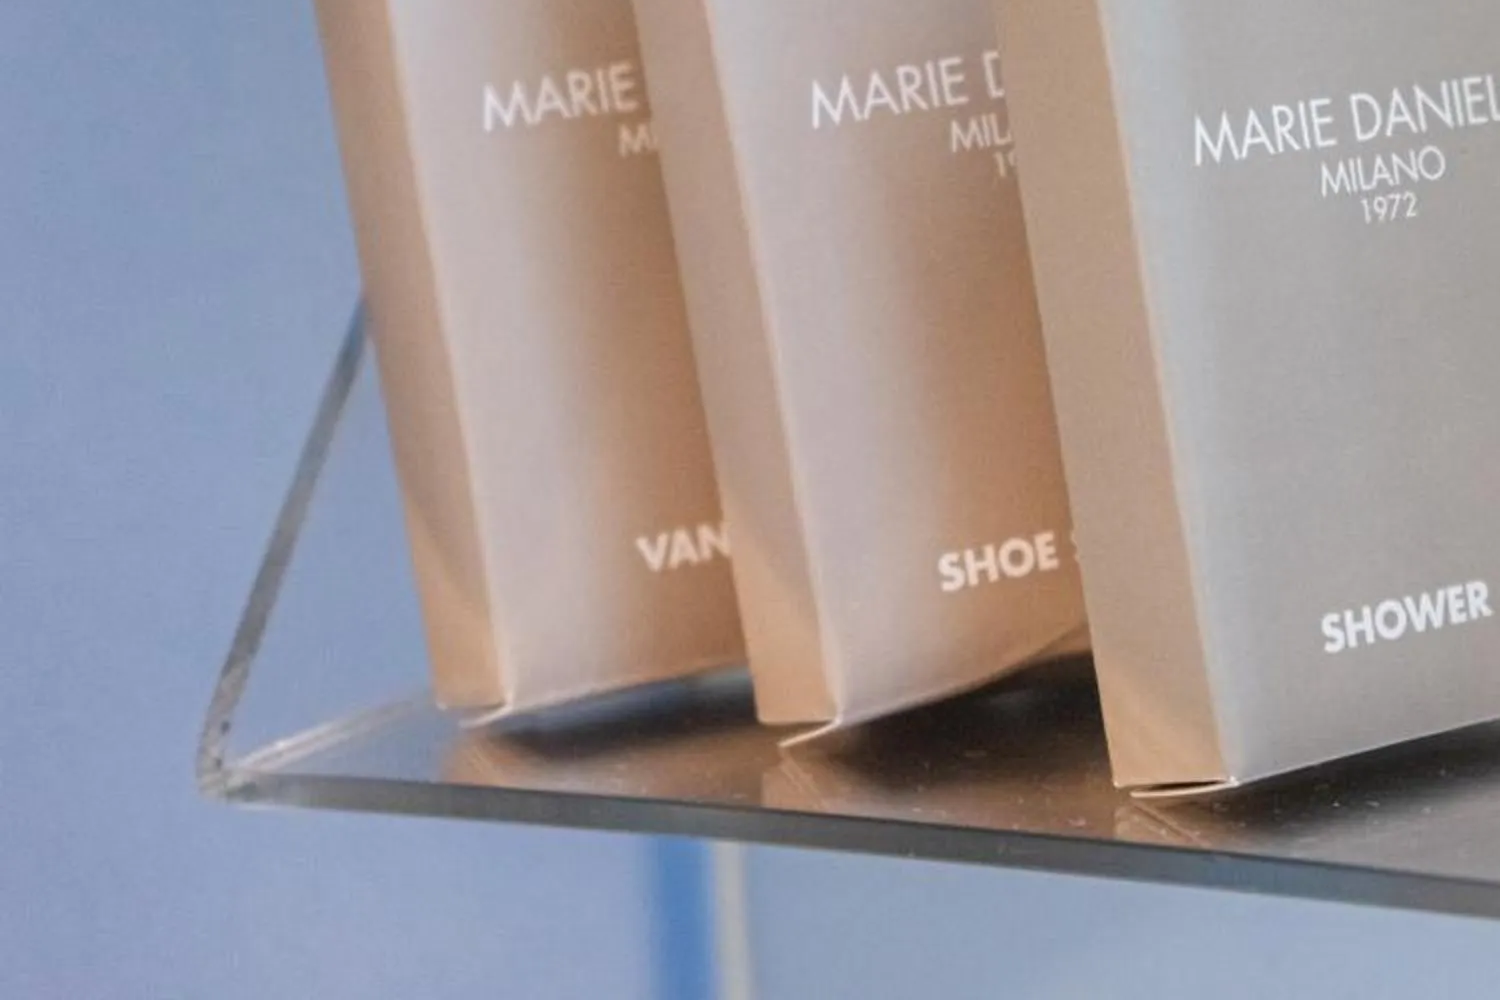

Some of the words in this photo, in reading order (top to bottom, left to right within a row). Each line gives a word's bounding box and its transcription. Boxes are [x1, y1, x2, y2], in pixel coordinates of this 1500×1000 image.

[484, 60, 640, 133] MARIE
[811, 55, 970, 131] MARIE
[952, 112, 1012, 153] MIL
[1194, 98, 1338, 168] MARIE
[1320, 145, 1447, 199] MILANO
[1360, 191, 1420, 225] 1972
[636, 523, 731, 573] VAN
[937, 529, 1060, 593] SHOE
[1320, 579, 1495, 654] SHOWER
